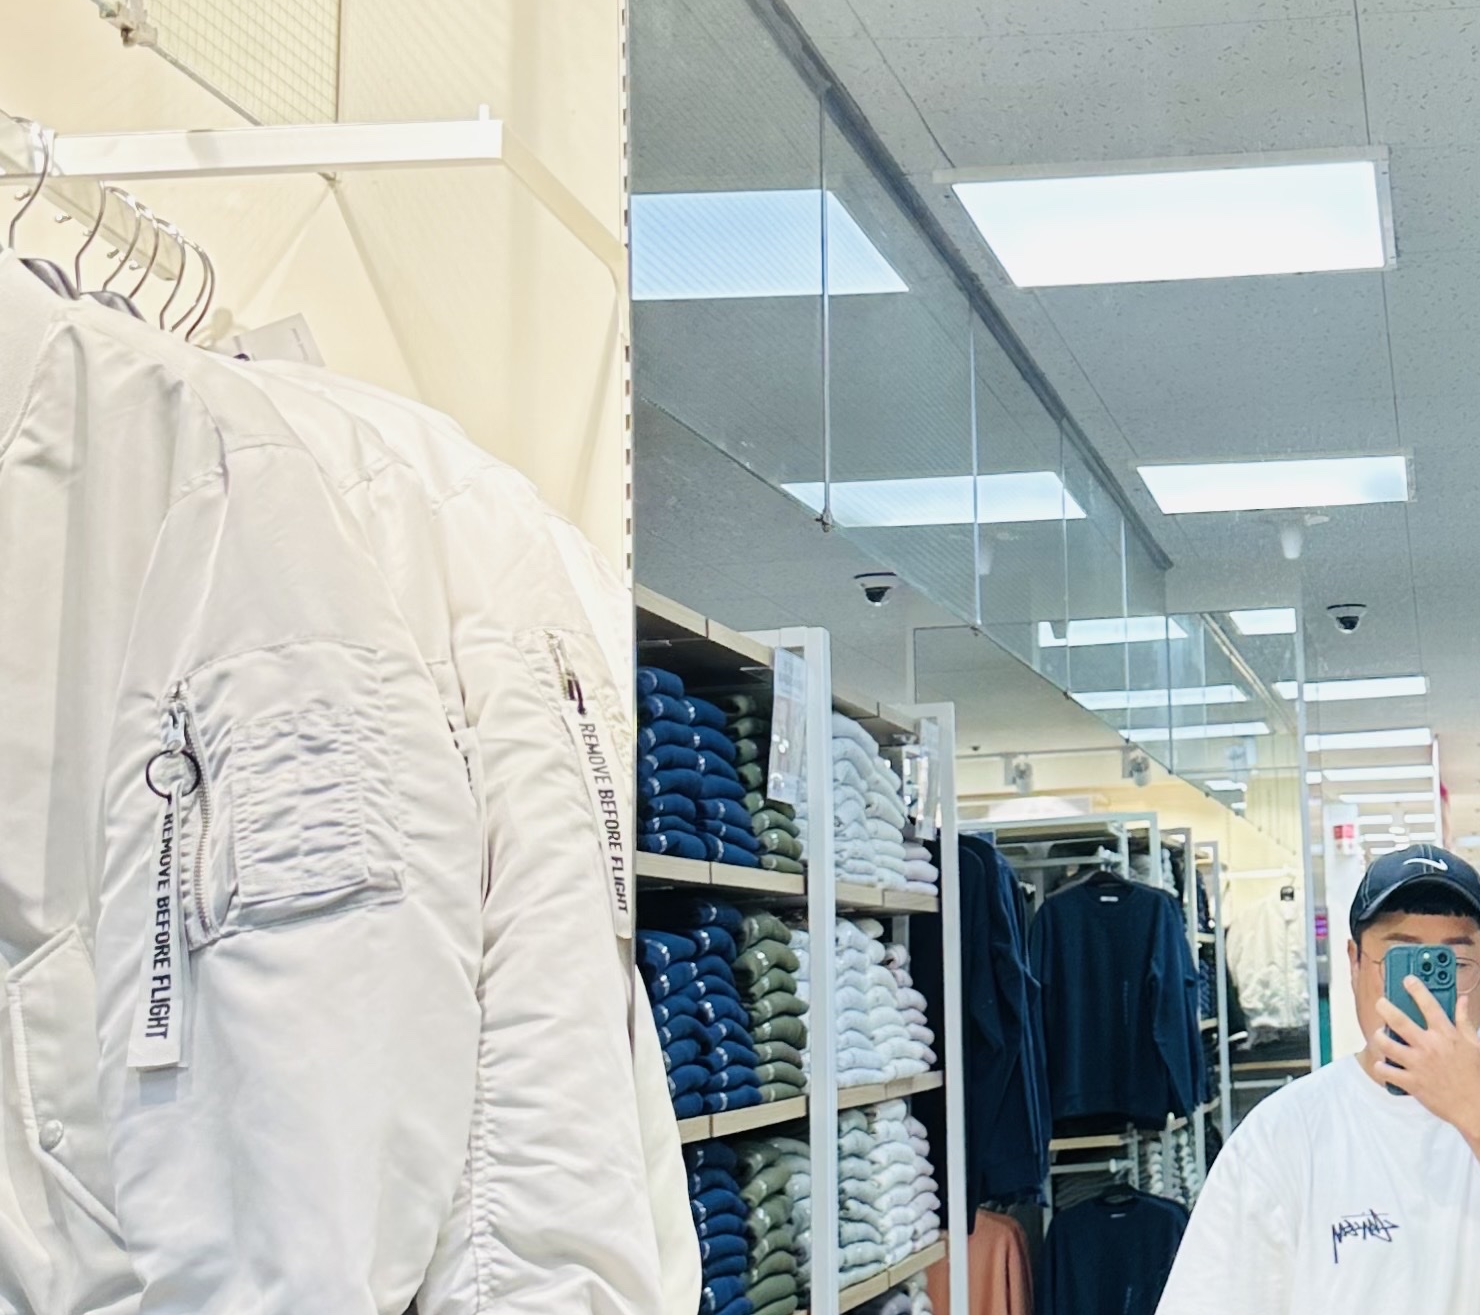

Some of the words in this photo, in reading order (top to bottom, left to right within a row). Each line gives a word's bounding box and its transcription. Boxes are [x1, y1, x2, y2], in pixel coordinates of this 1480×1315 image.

[157, 813, 174, 892] REMOVE
[578, 722, 613, 785] REMOVE
[597, 788, 623, 853] BEFORE
[610, 855, 629, 914] FLIGHT
[153, 896, 171, 971] BEFORE
[145, 974, 171, 1040] FLIGHT
